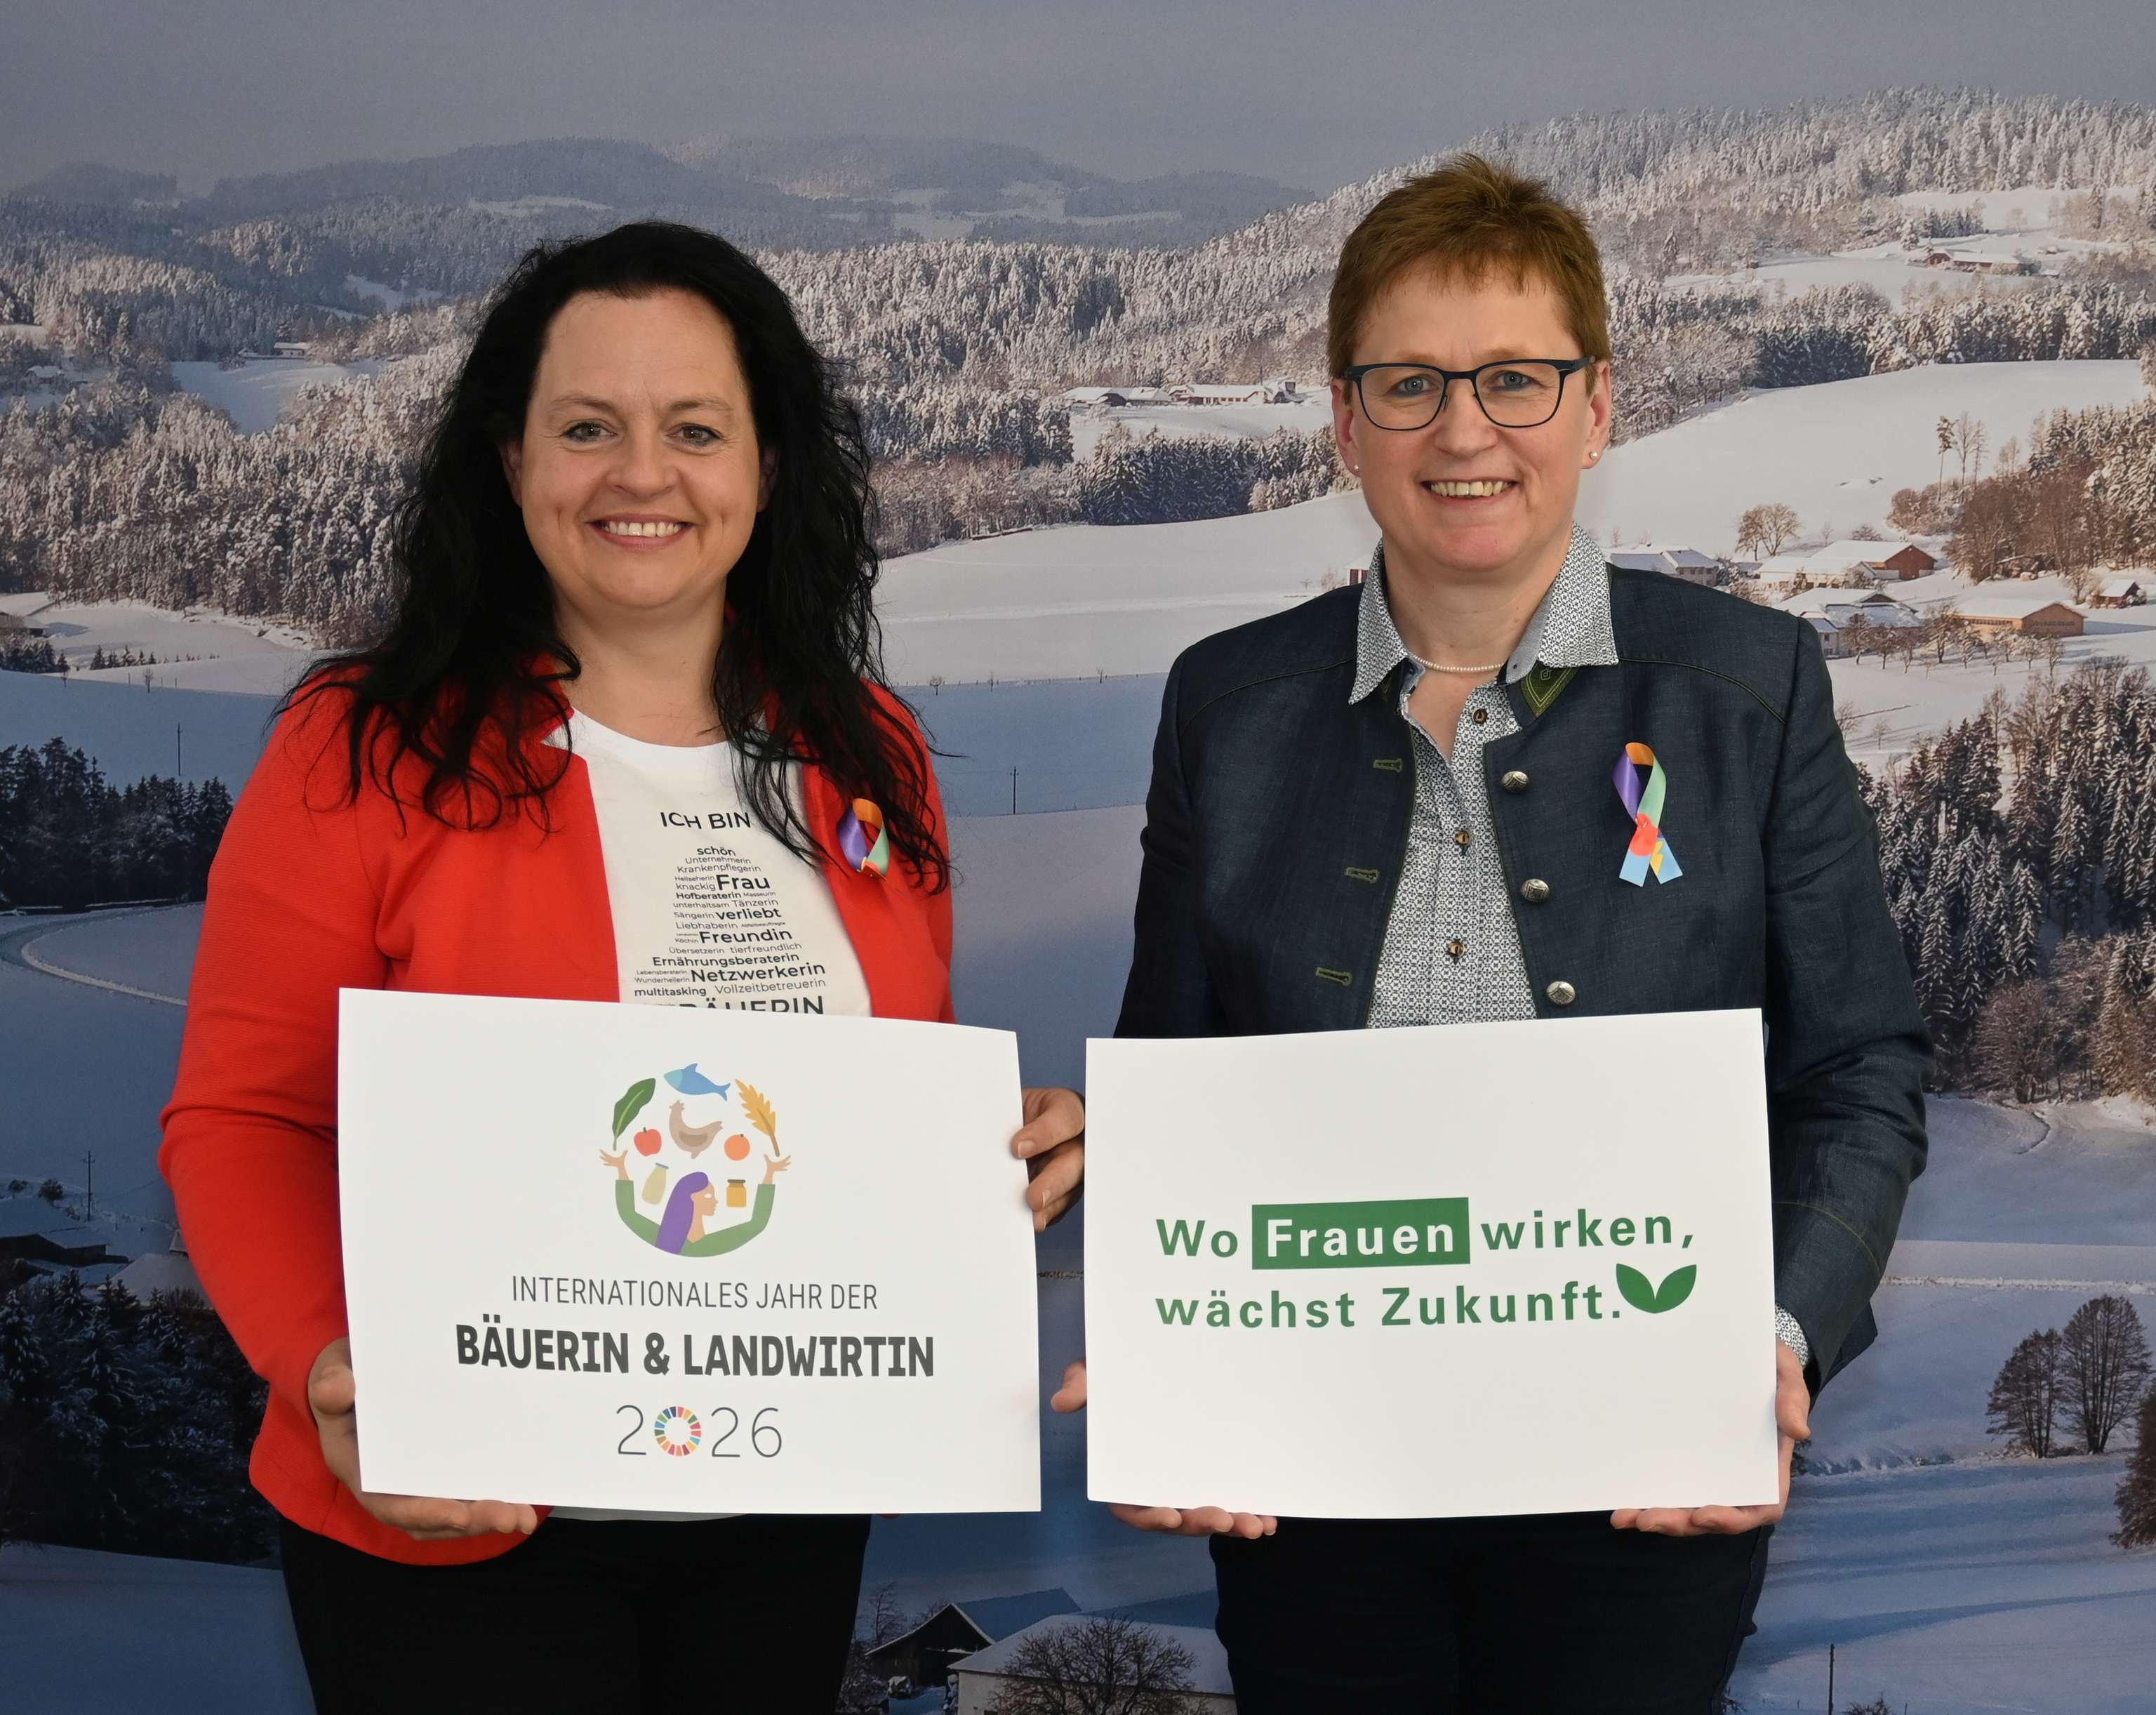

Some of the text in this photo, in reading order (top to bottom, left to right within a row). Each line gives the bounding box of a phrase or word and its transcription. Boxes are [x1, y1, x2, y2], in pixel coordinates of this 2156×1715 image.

[660, 812, 752, 829] ICH BIN
[697, 846, 736, 856] schön
[677, 863, 761, 873] Krankenpflegerin
[685, 856, 752, 864] Unternehmerin
[675, 874, 771, 892] knackig Frau
[731, 899, 779, 908] Tänzerin
[674, 908, 782, 920] Sängerin verliebt
[699, 929, 792, 943] Freundin
[730, 942, 802, 954] tierfreundlich
[653, 953, 800, 967] Ernährungsberaterin
[691, 962, 825, 982] Netzwerkerin
[634, 978, 827, 997] multitasking Vollzeitbetreuerin
[679, 995, 824, 1014] ERIN
[1155, 1208, 1693, 1258] Wo Frauen wirken,
[512, 1275, 877, 1310] INTERNATIONALES JAHR DER
[1155, 1280, 1621, 1328] wächst Zukunft.
[455, 1313, 934, 1377] BÄUERIN & LANDWIRTIN
[616, 1404, 782, 1458] 2026
